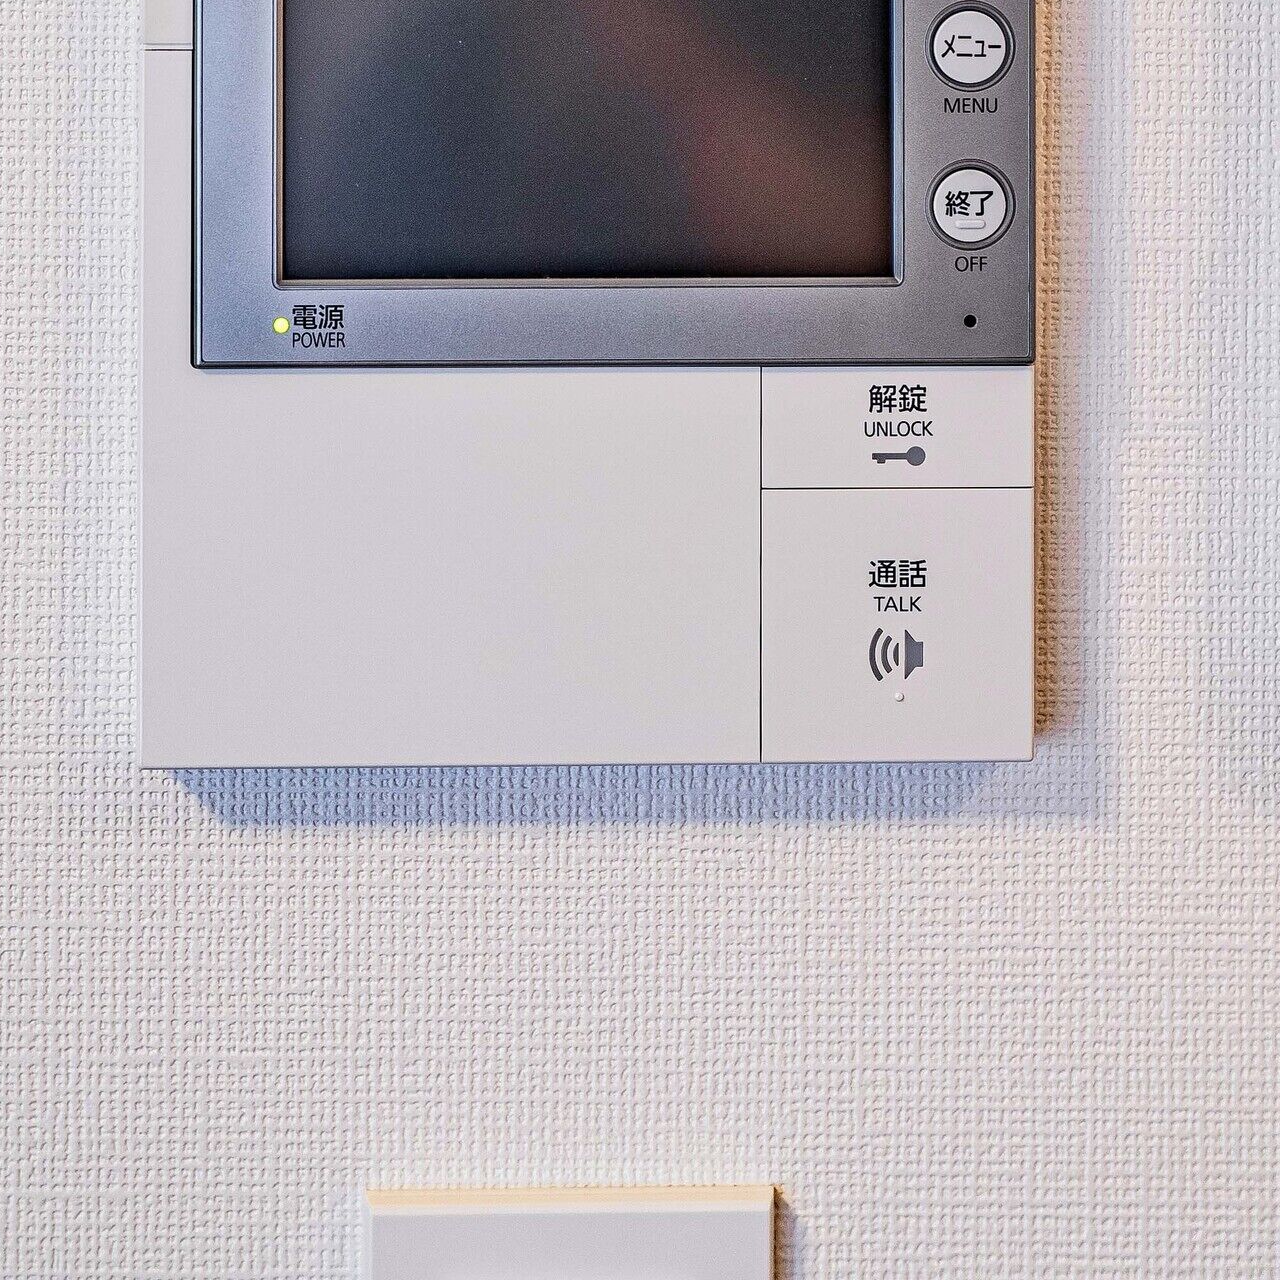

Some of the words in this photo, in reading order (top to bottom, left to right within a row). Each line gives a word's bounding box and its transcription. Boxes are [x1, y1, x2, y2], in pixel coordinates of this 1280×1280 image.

[942, 35, 1001, 57] メニュー
[944, 98, 998, 114] MENU
[945, 191, 993, 217] 終了
[955, 256, 987, 272] OFF
[292, 305, 344, 330] 電源
[293, 332, 345, 348] POWER
[869, 385, 927, 413] 解錠
[865, 421, 933, 437] UNLOCK
[869, 560, 927, 587] 通話
[873, 596, 921, 612] TALK
